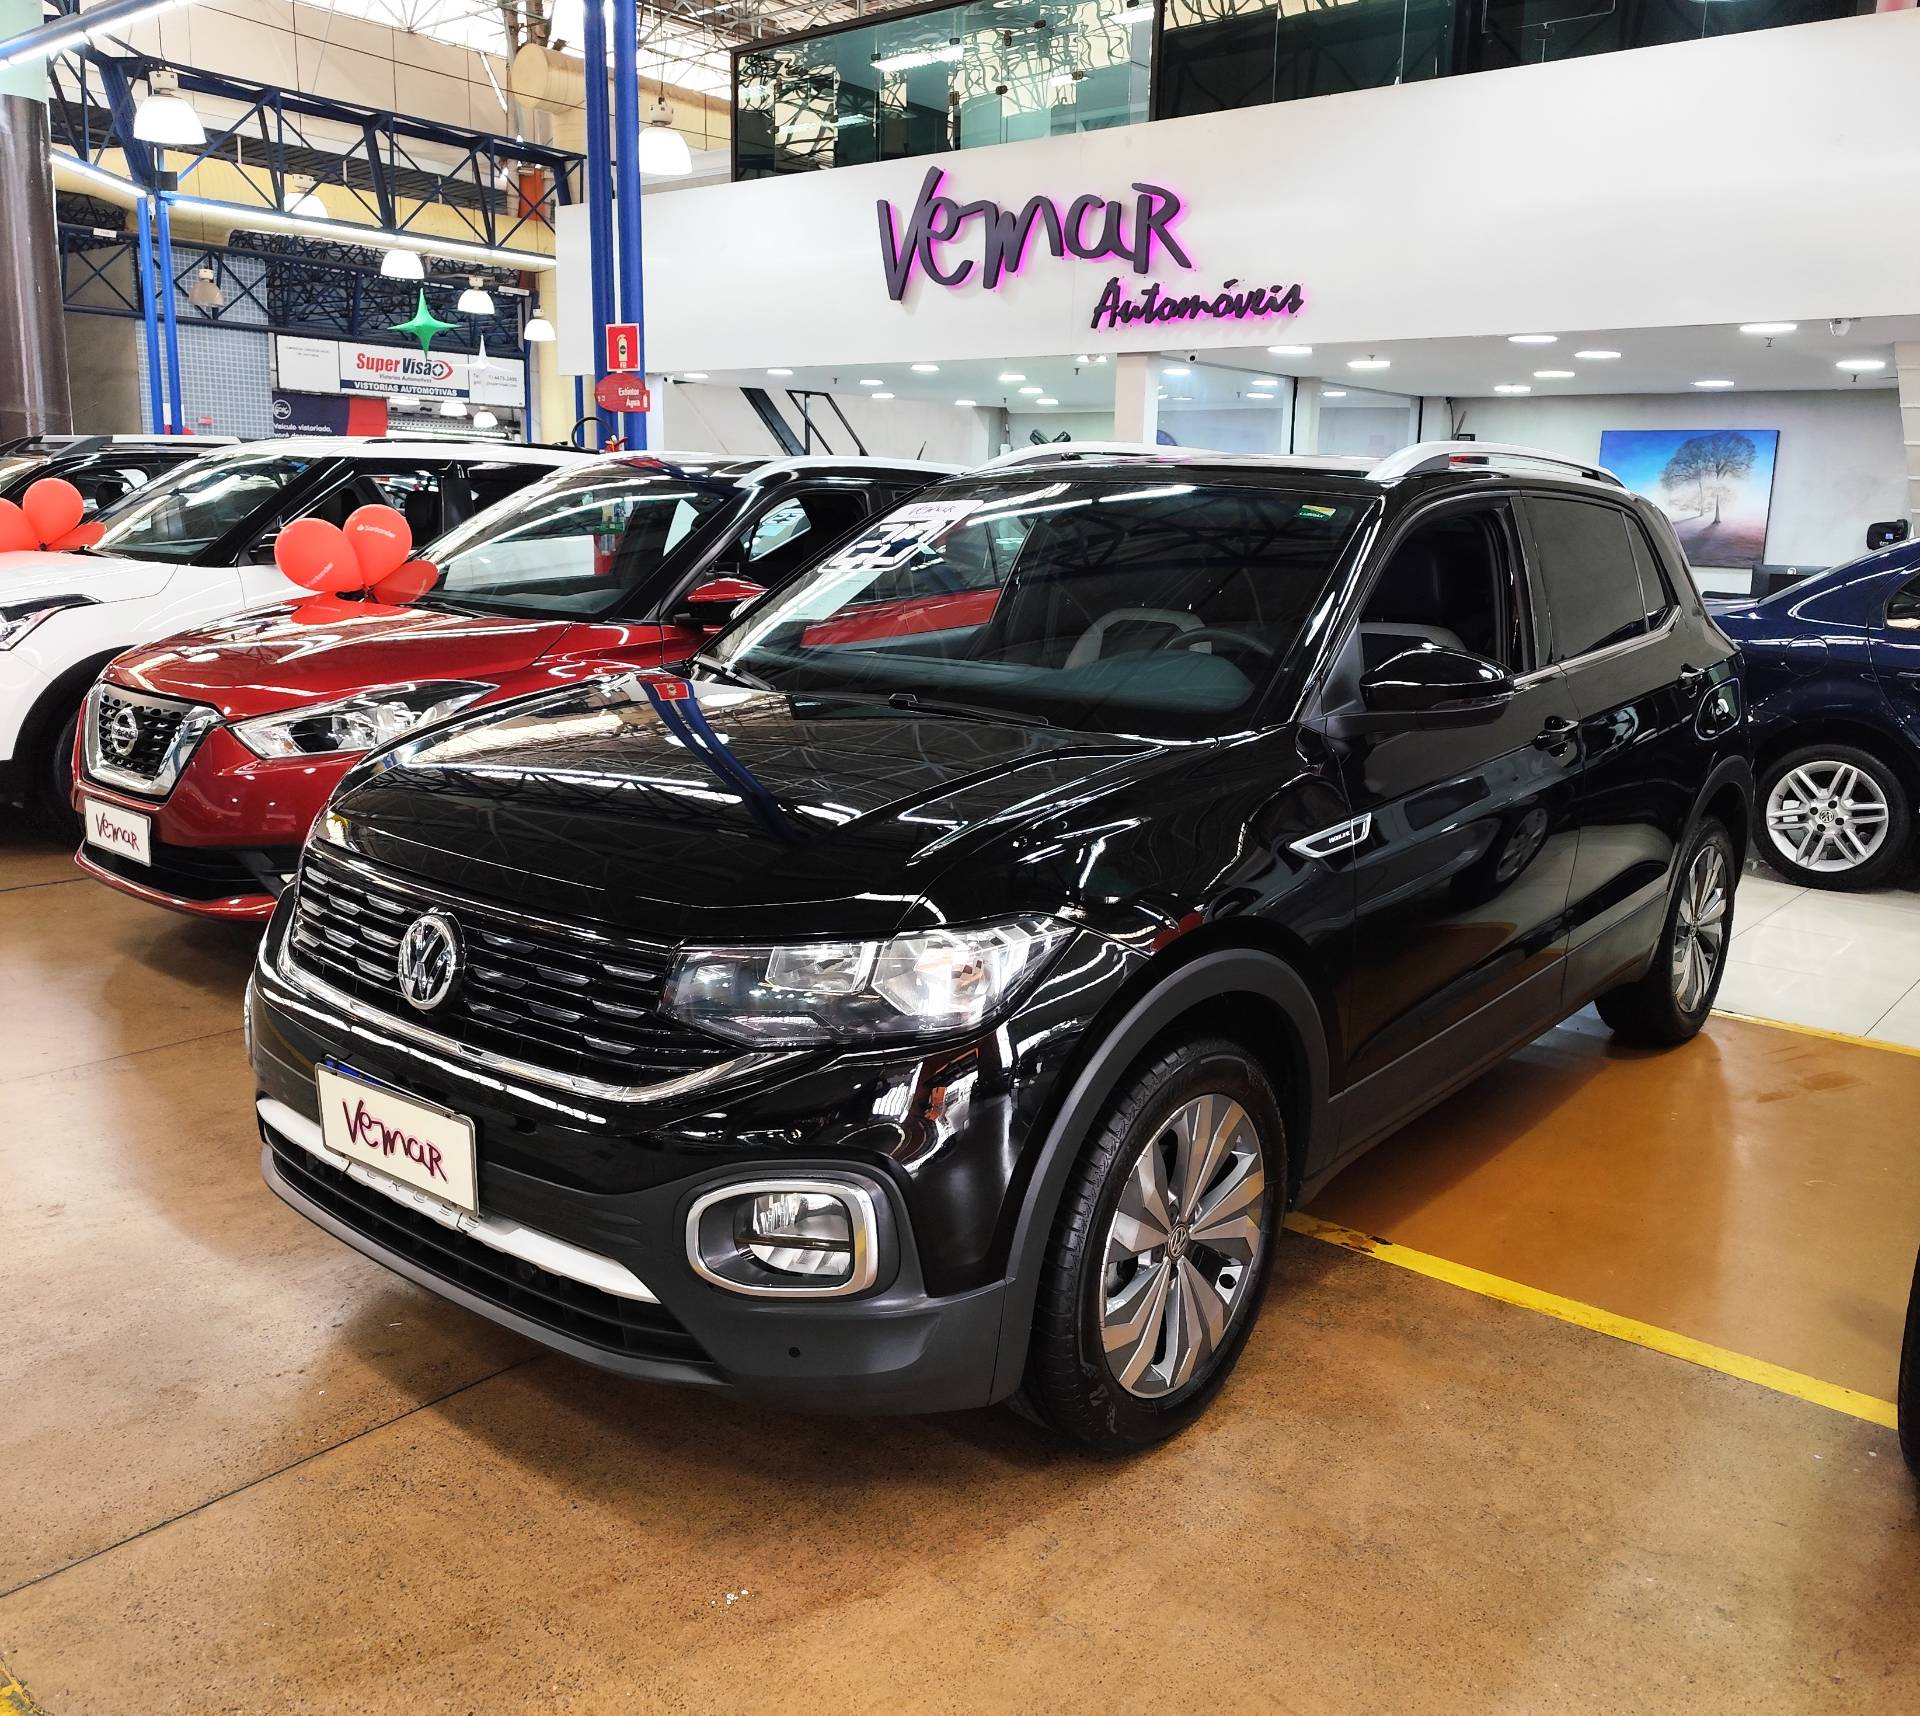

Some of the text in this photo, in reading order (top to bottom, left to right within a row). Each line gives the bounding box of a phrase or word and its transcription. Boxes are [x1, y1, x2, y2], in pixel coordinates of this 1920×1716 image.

[1090, 277, 1304, 329] Automóveis
[357, 352, 400, 373] Super
[354, 381, 458, 397] VISTORIAS AUTOMOTIVAS
